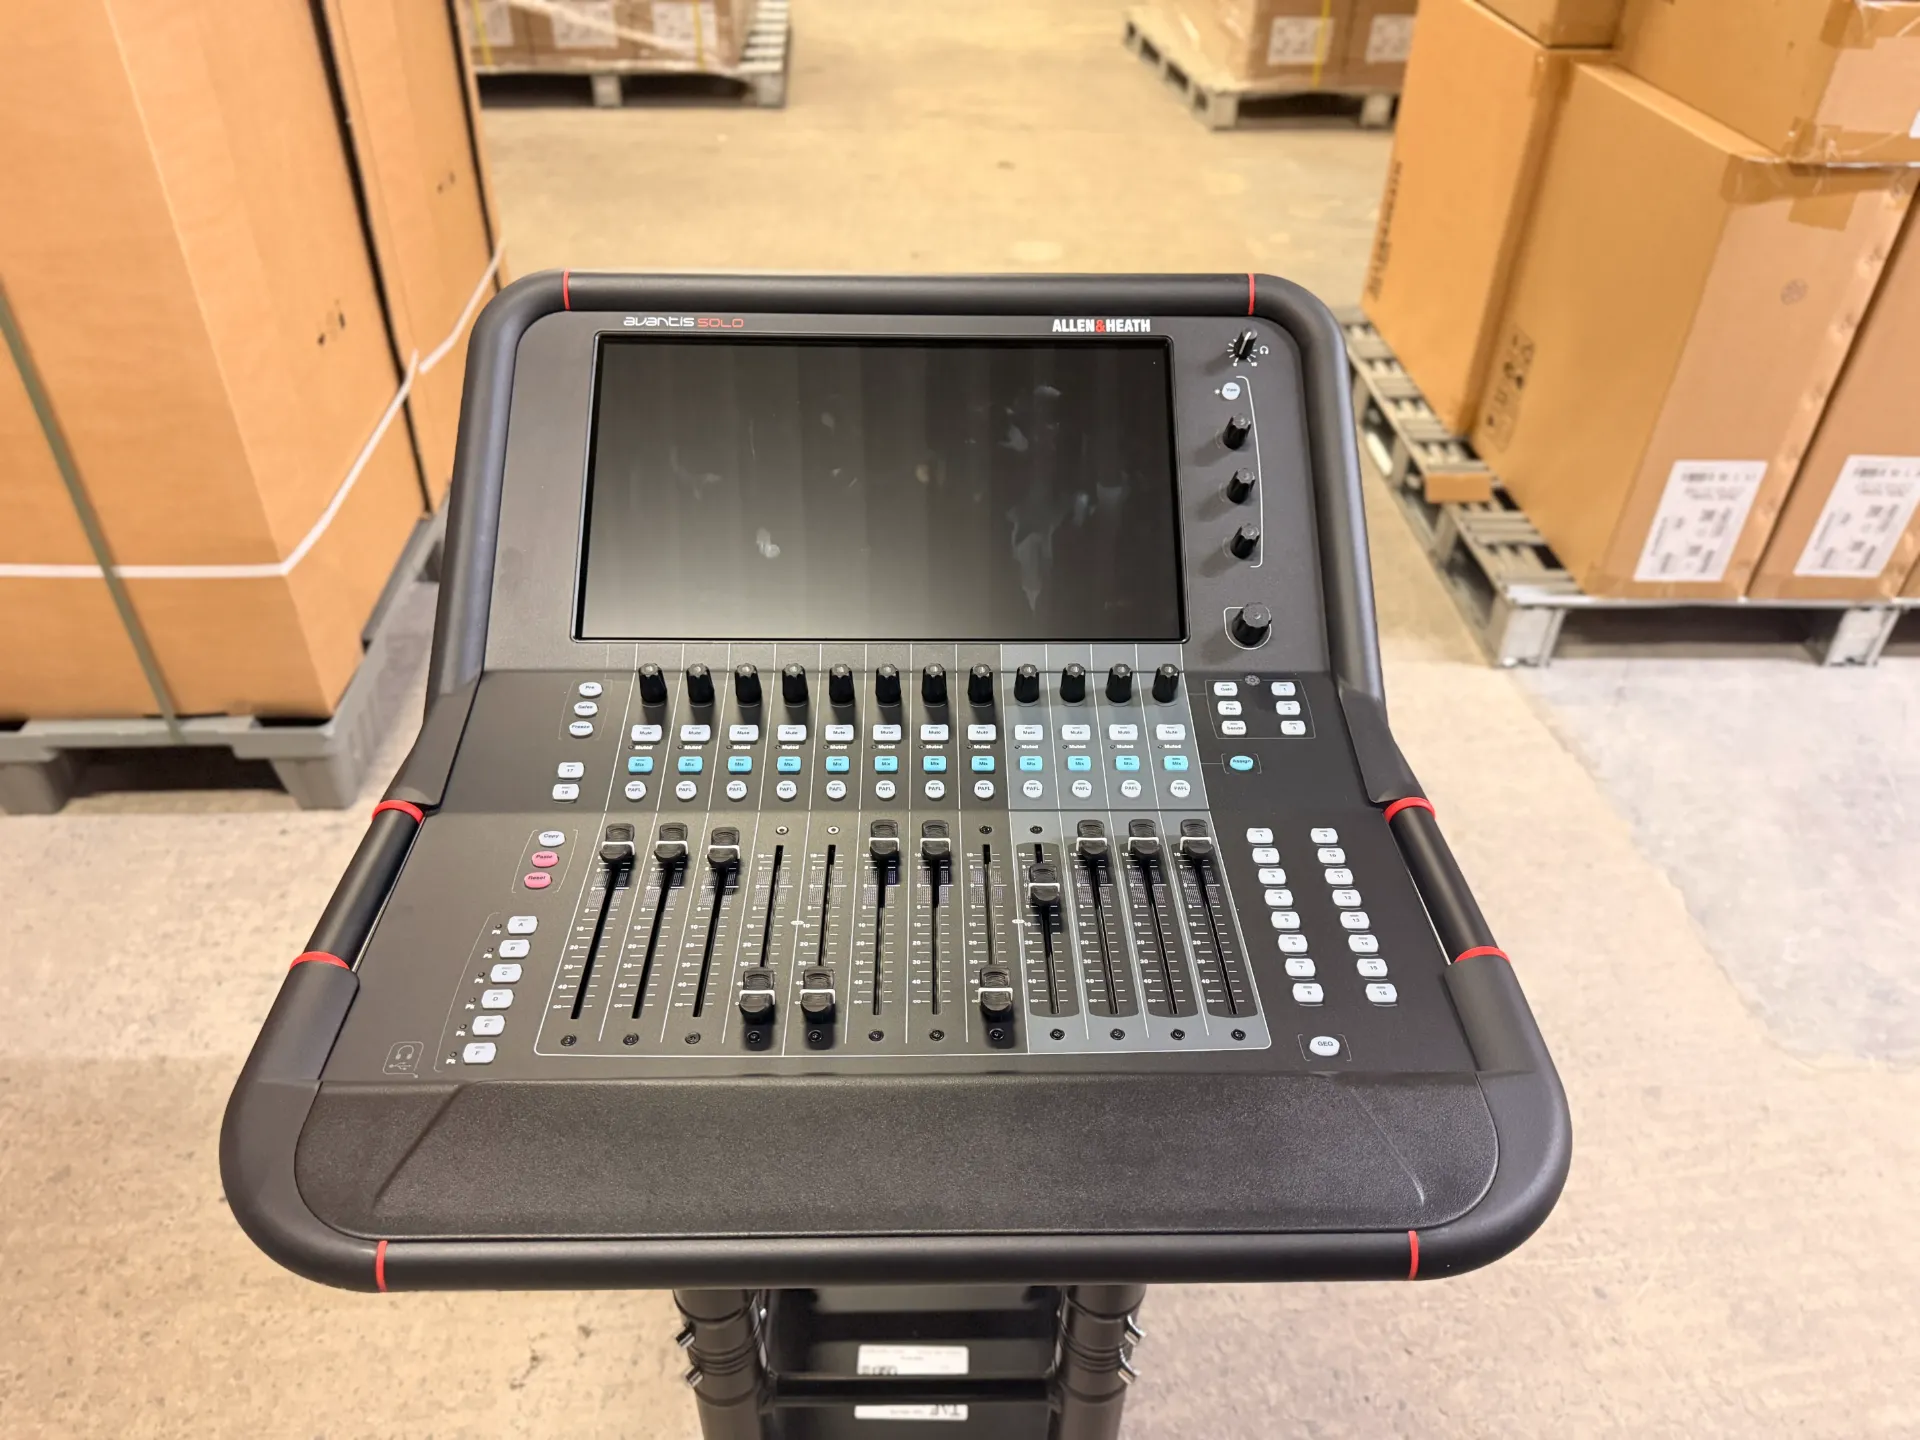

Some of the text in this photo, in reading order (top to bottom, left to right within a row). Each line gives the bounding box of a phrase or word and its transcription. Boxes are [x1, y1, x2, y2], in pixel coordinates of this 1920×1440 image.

[624, 317, 745, 328] avantis SOLO
[1052, 318, 1151, 333] ALLEN&HEATH
